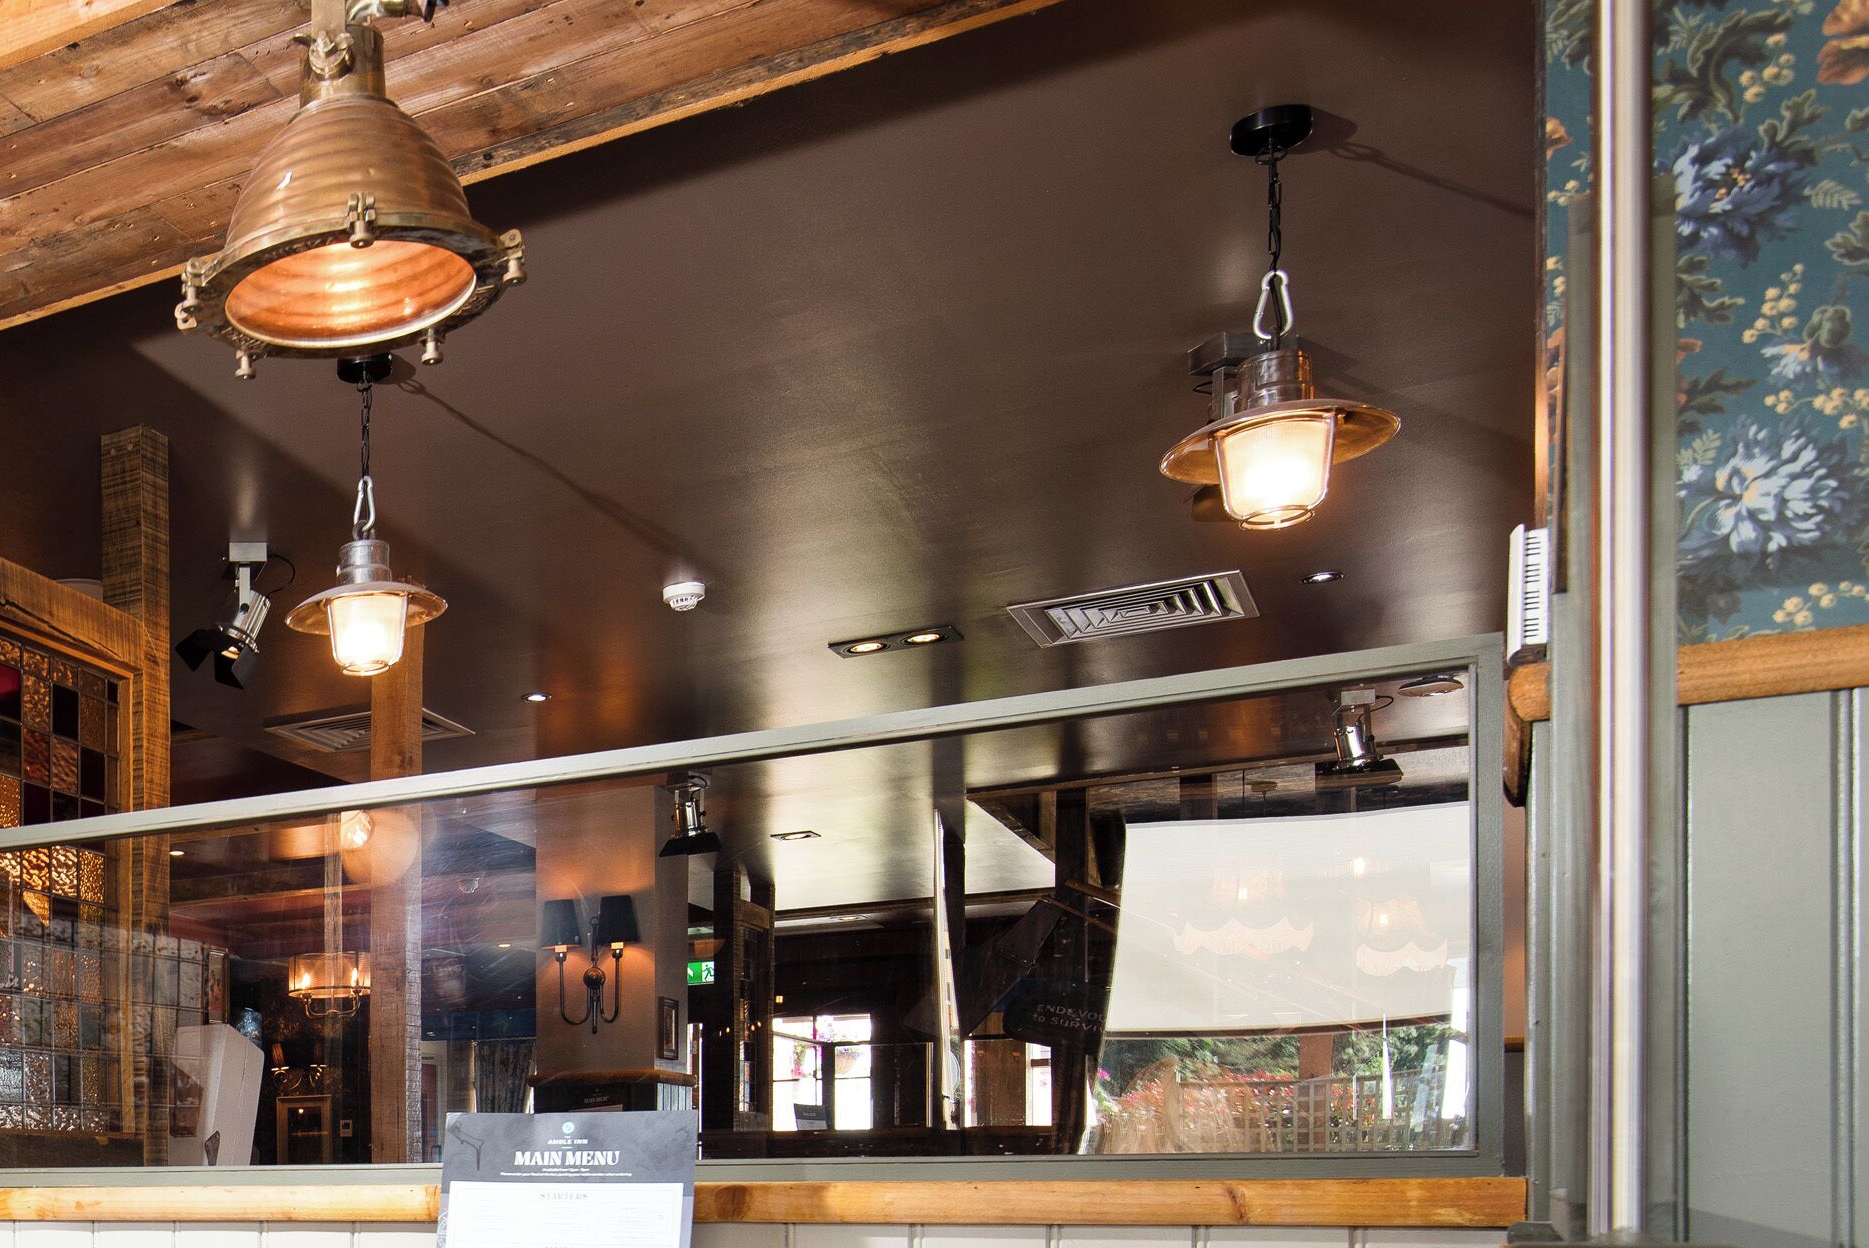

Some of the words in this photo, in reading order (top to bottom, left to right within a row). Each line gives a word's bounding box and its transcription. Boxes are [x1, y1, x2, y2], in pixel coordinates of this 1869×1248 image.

[1032, 1012, 1045, 1022] to
[514, 1150, 562, 1166] MAIN
[564, 1150, 620, 1166] MENU
[540, 1192, 589, 1201] STARTERS
